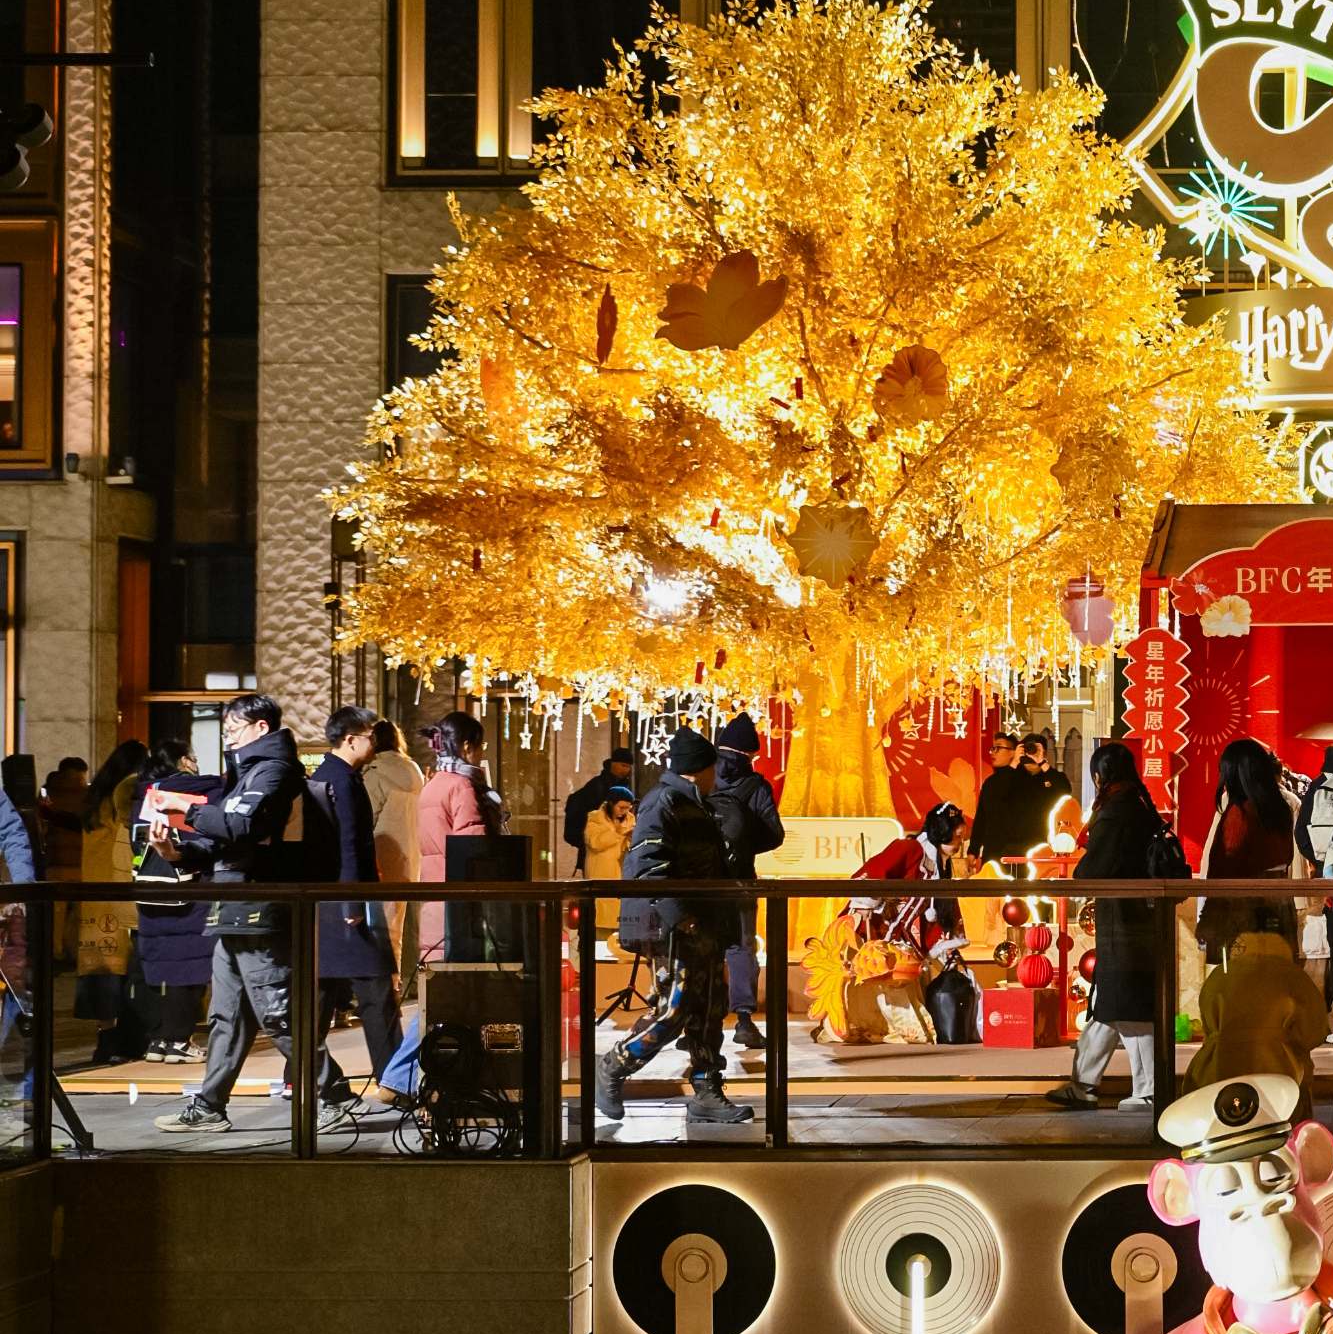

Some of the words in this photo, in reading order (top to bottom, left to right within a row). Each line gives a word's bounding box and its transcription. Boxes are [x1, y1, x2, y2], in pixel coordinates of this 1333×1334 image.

[1143, 641, 1166, 778] 星年祈愿小屋
[814, 835, 872, 860] BFC
